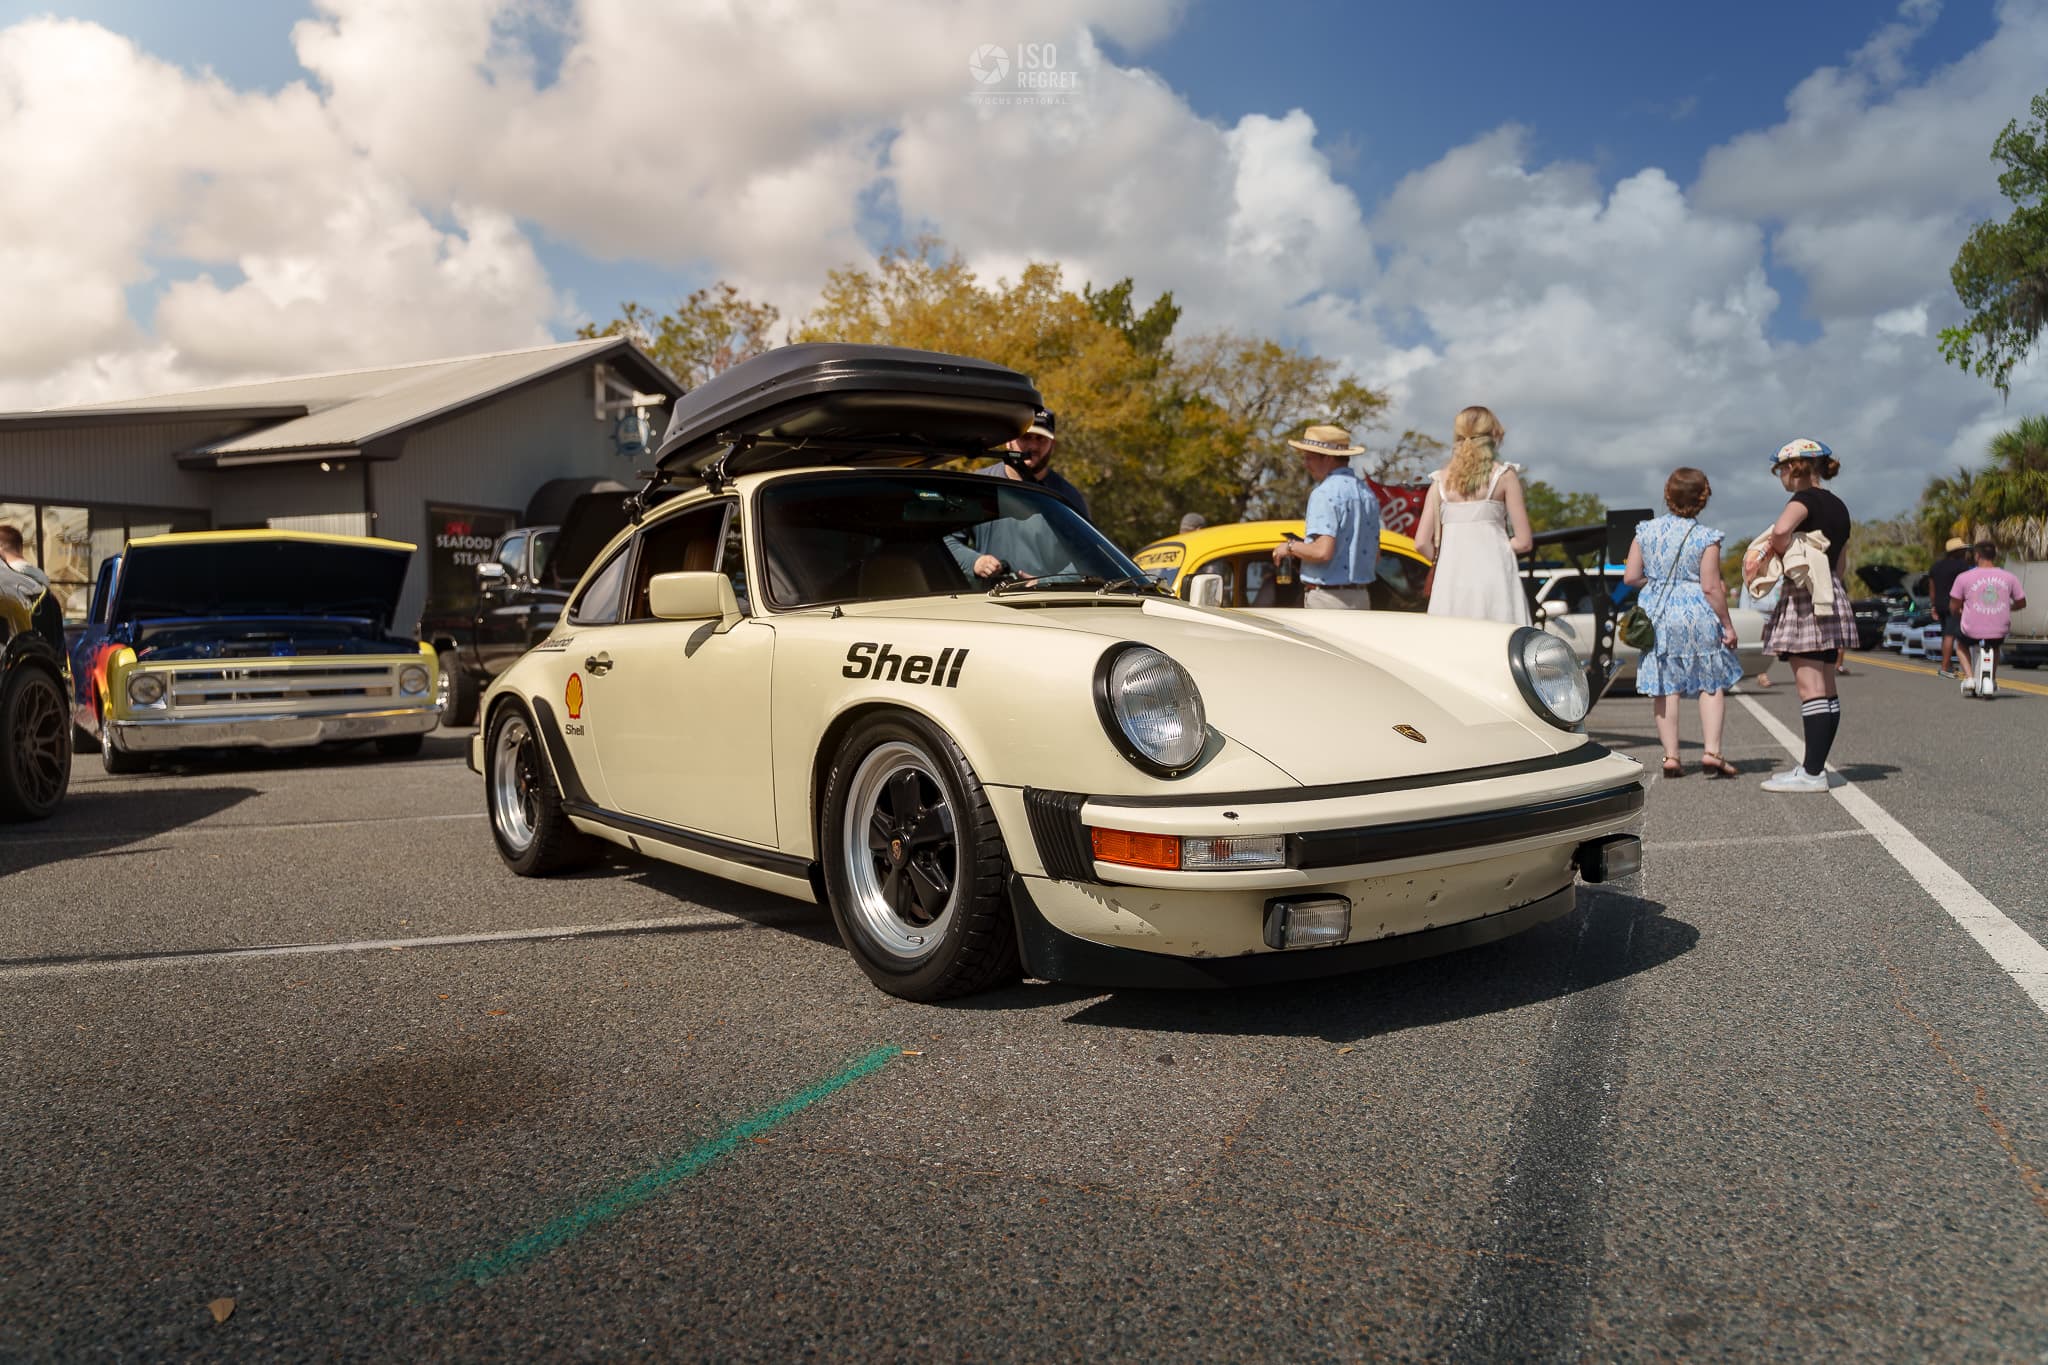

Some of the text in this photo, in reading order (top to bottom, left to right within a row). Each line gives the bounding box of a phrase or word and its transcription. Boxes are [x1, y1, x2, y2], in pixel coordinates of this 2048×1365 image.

[436, 534, 492, 550] SEAFOOD
[842, 642, 970, 688] Shell
[565, 724, 585, 736] Shell
